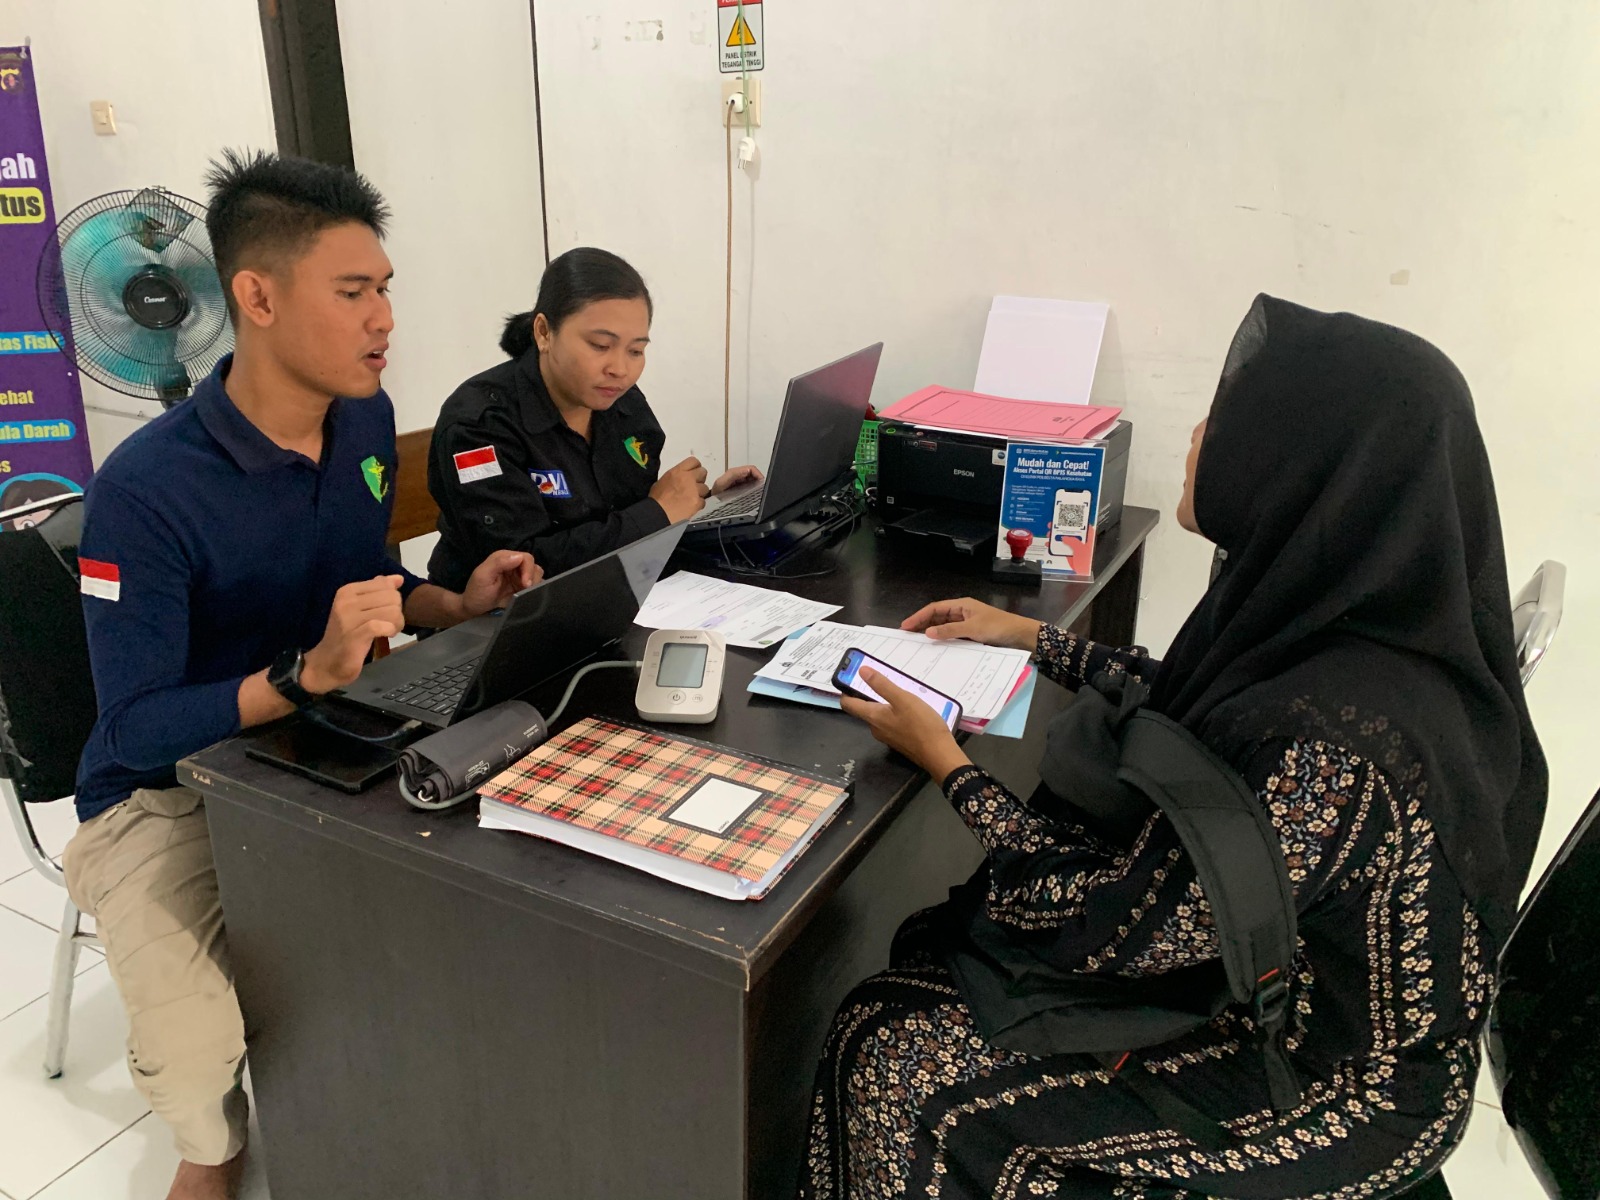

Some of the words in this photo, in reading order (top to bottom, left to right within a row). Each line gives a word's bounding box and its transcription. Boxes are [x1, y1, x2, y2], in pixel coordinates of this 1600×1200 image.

[0, 152, 37, 180] ah
[23, 422, 70, 439] Darah
[1017, 457, 1044, 468] Mudah
[1046, 459, 1061, 469] dan
[1063, 459, 1090, 471] Cepat!
[953, 469, 975, 478] EPSON
